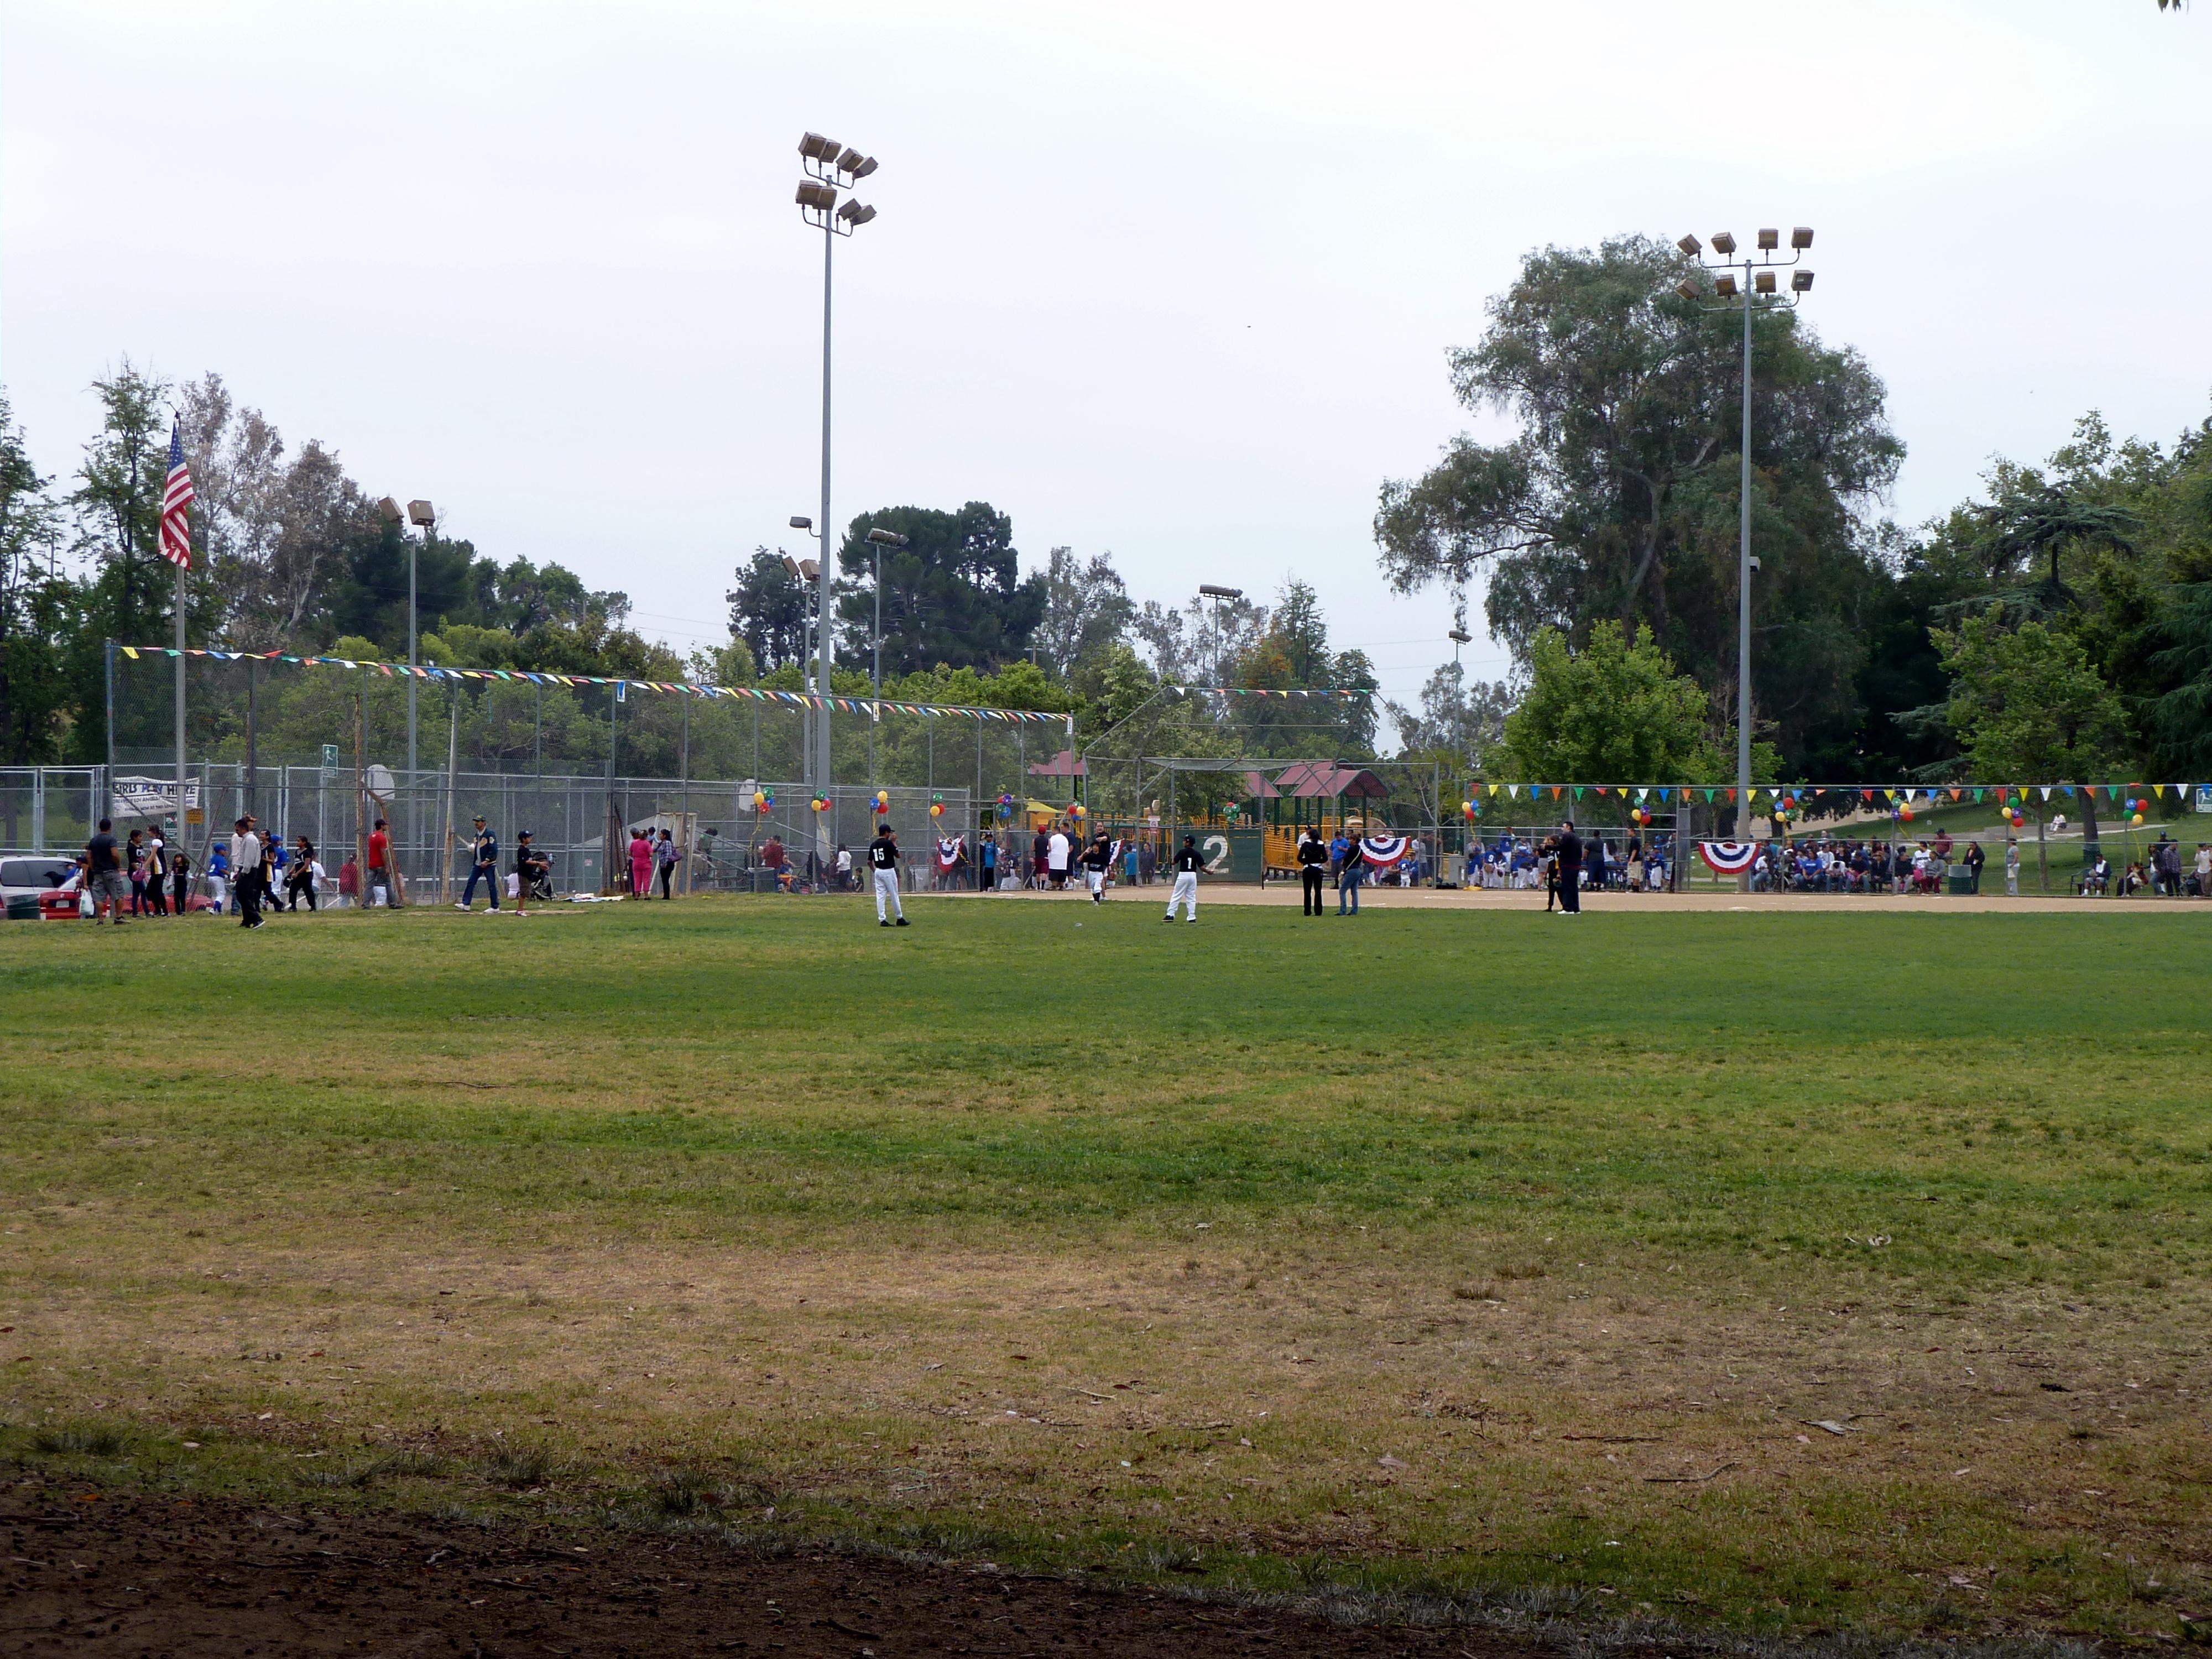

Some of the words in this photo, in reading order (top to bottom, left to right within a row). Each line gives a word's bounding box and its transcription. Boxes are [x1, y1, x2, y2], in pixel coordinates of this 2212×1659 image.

[167, 785, 195, 795] HRE
[873, 848, 885, 862] 15
[1202, 835, 1229, 874] 2
[1187, 857, 1192, 869] 1
